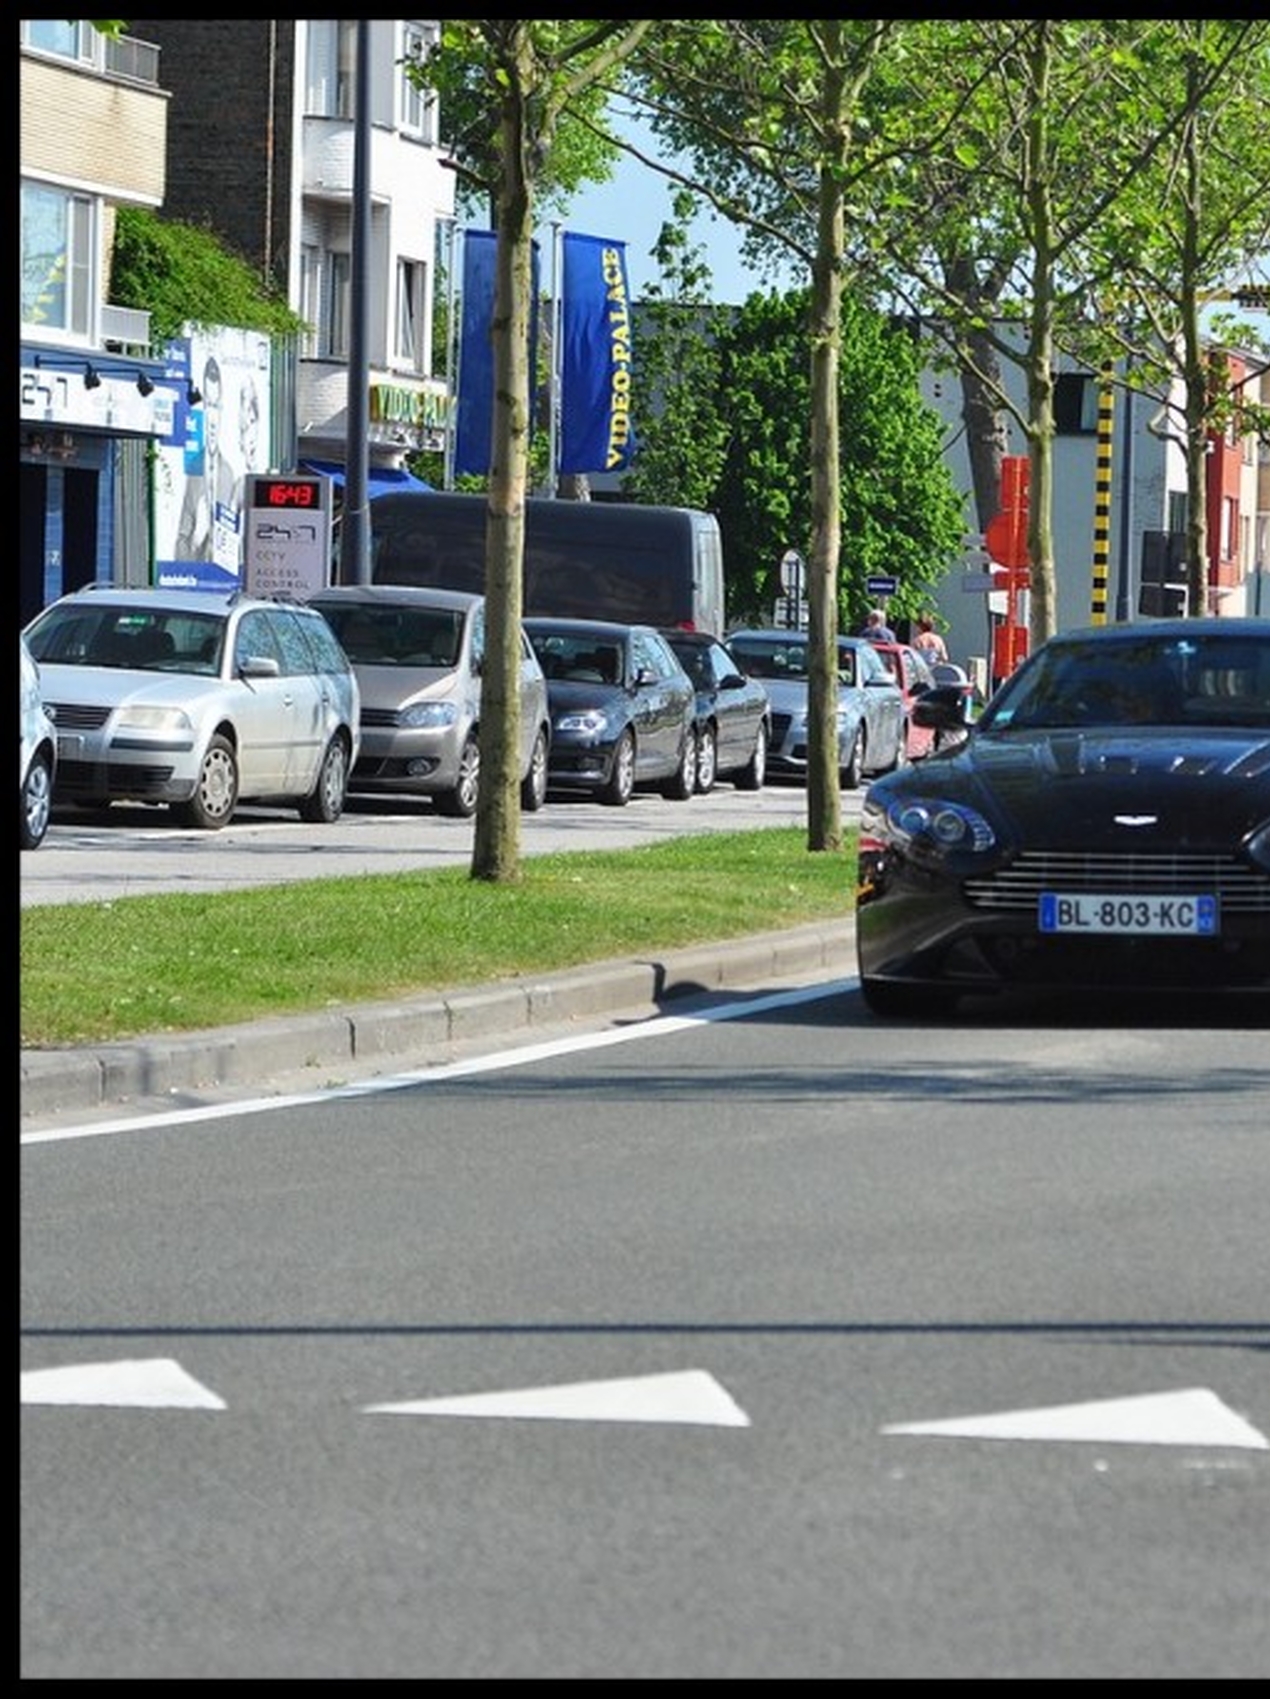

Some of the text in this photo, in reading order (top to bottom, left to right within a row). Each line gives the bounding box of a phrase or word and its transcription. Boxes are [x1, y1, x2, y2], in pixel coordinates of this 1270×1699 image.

[256, 568, 299, 578] ACCESS
[256, 580, 312, 590] CONTROL
[1058, 901, 1193, 928] BL-803-KC
